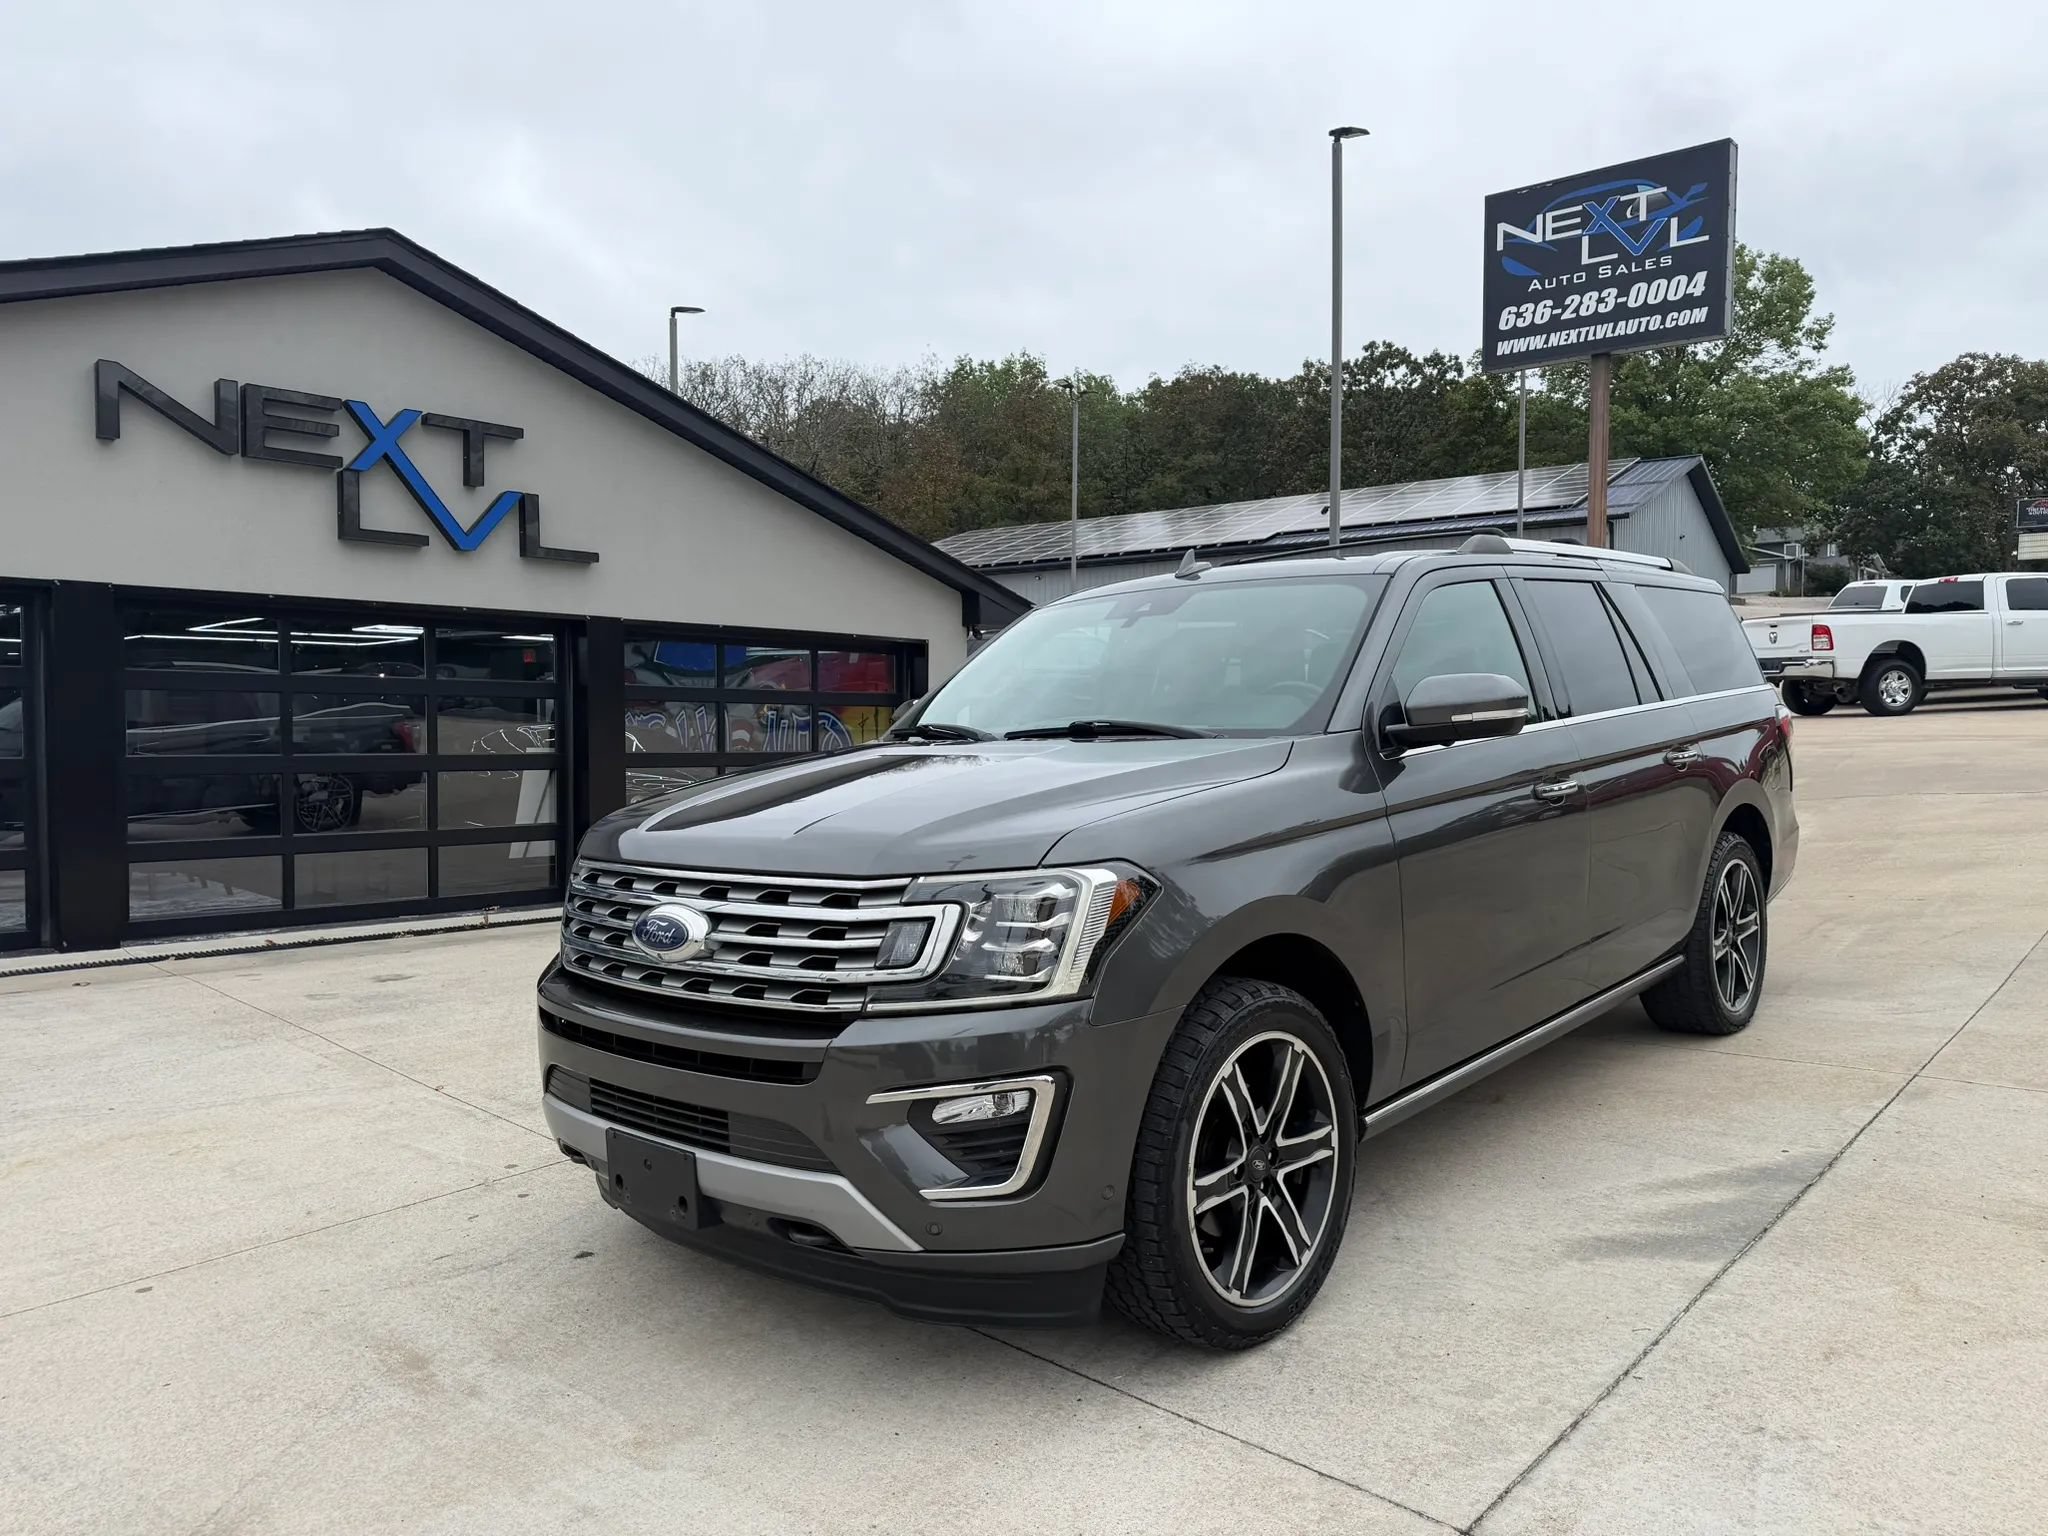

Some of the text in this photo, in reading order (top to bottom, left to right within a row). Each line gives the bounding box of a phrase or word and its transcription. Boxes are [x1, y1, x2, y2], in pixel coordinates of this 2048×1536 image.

[1496, 185, 1668, 251] NEXT
[1580, 216, 1710, 265] LVL
[1498, 270, 1708, 331] 636-283-0004
[1527, 255, 1673, 292] AUTO SALES
[1496, 306, 1709, 356] WWW.NEXTLVLAUTO.COM
[95, 358, 524, 488] NEXT
[337, 469, 600, 564] LVL
[641, 918, 676, 944] Ford
